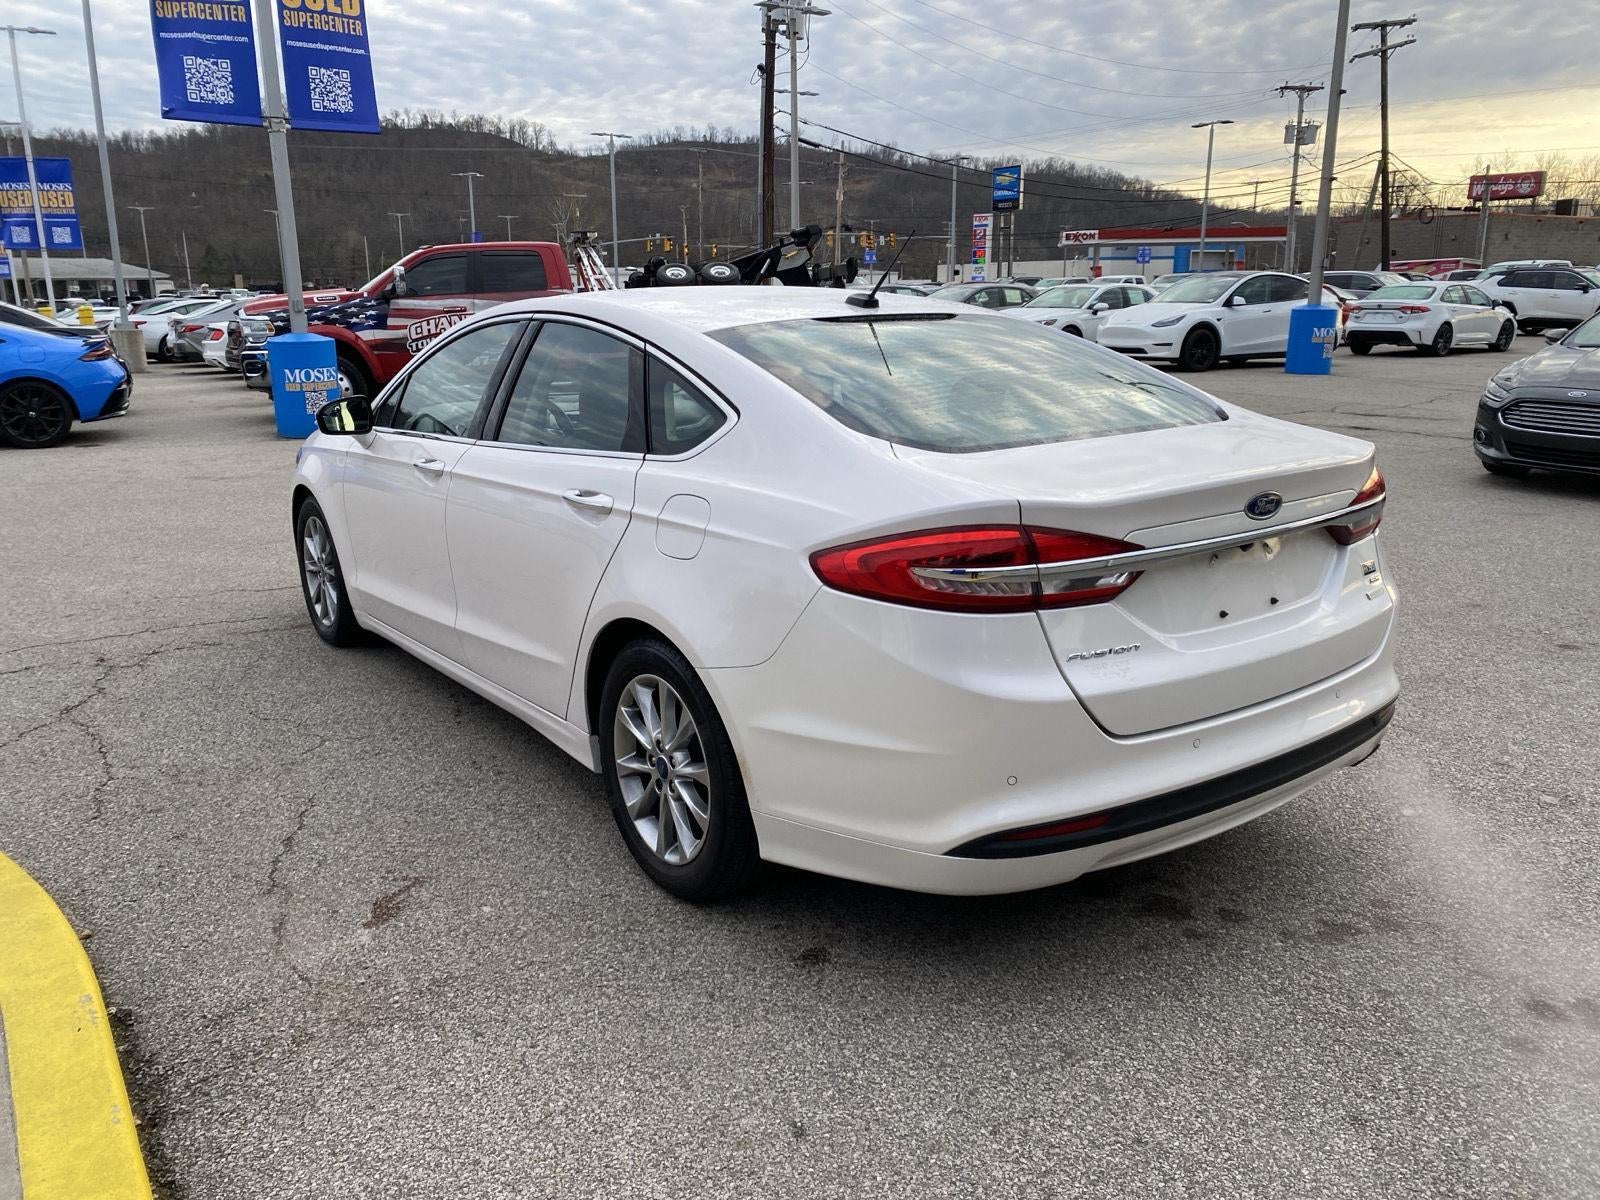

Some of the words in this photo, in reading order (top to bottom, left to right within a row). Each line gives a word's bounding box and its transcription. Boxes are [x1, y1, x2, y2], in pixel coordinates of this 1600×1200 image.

[155, 0, 247, 22] SUPERCENTER
[282, 9, 364, 37] SUPERCENTER
[160, 31, 248, 42] mosesusedsupercenter.com
[286, 40, 368, 55] mosesusedsupercenter.com
[37, 183, 72, 191] MOSES
[1472, 176, 1516, 197] Wndy's
[0, 191, 32, 207] USED
[39, 191, 74, 207] USED
[1065, 231, 1097, 243] EXXON
[409, 313, 471, 340] CHAN
[283, 366, 338, 383] MOSES
[1066, 643, 1141, 662] FUSION
